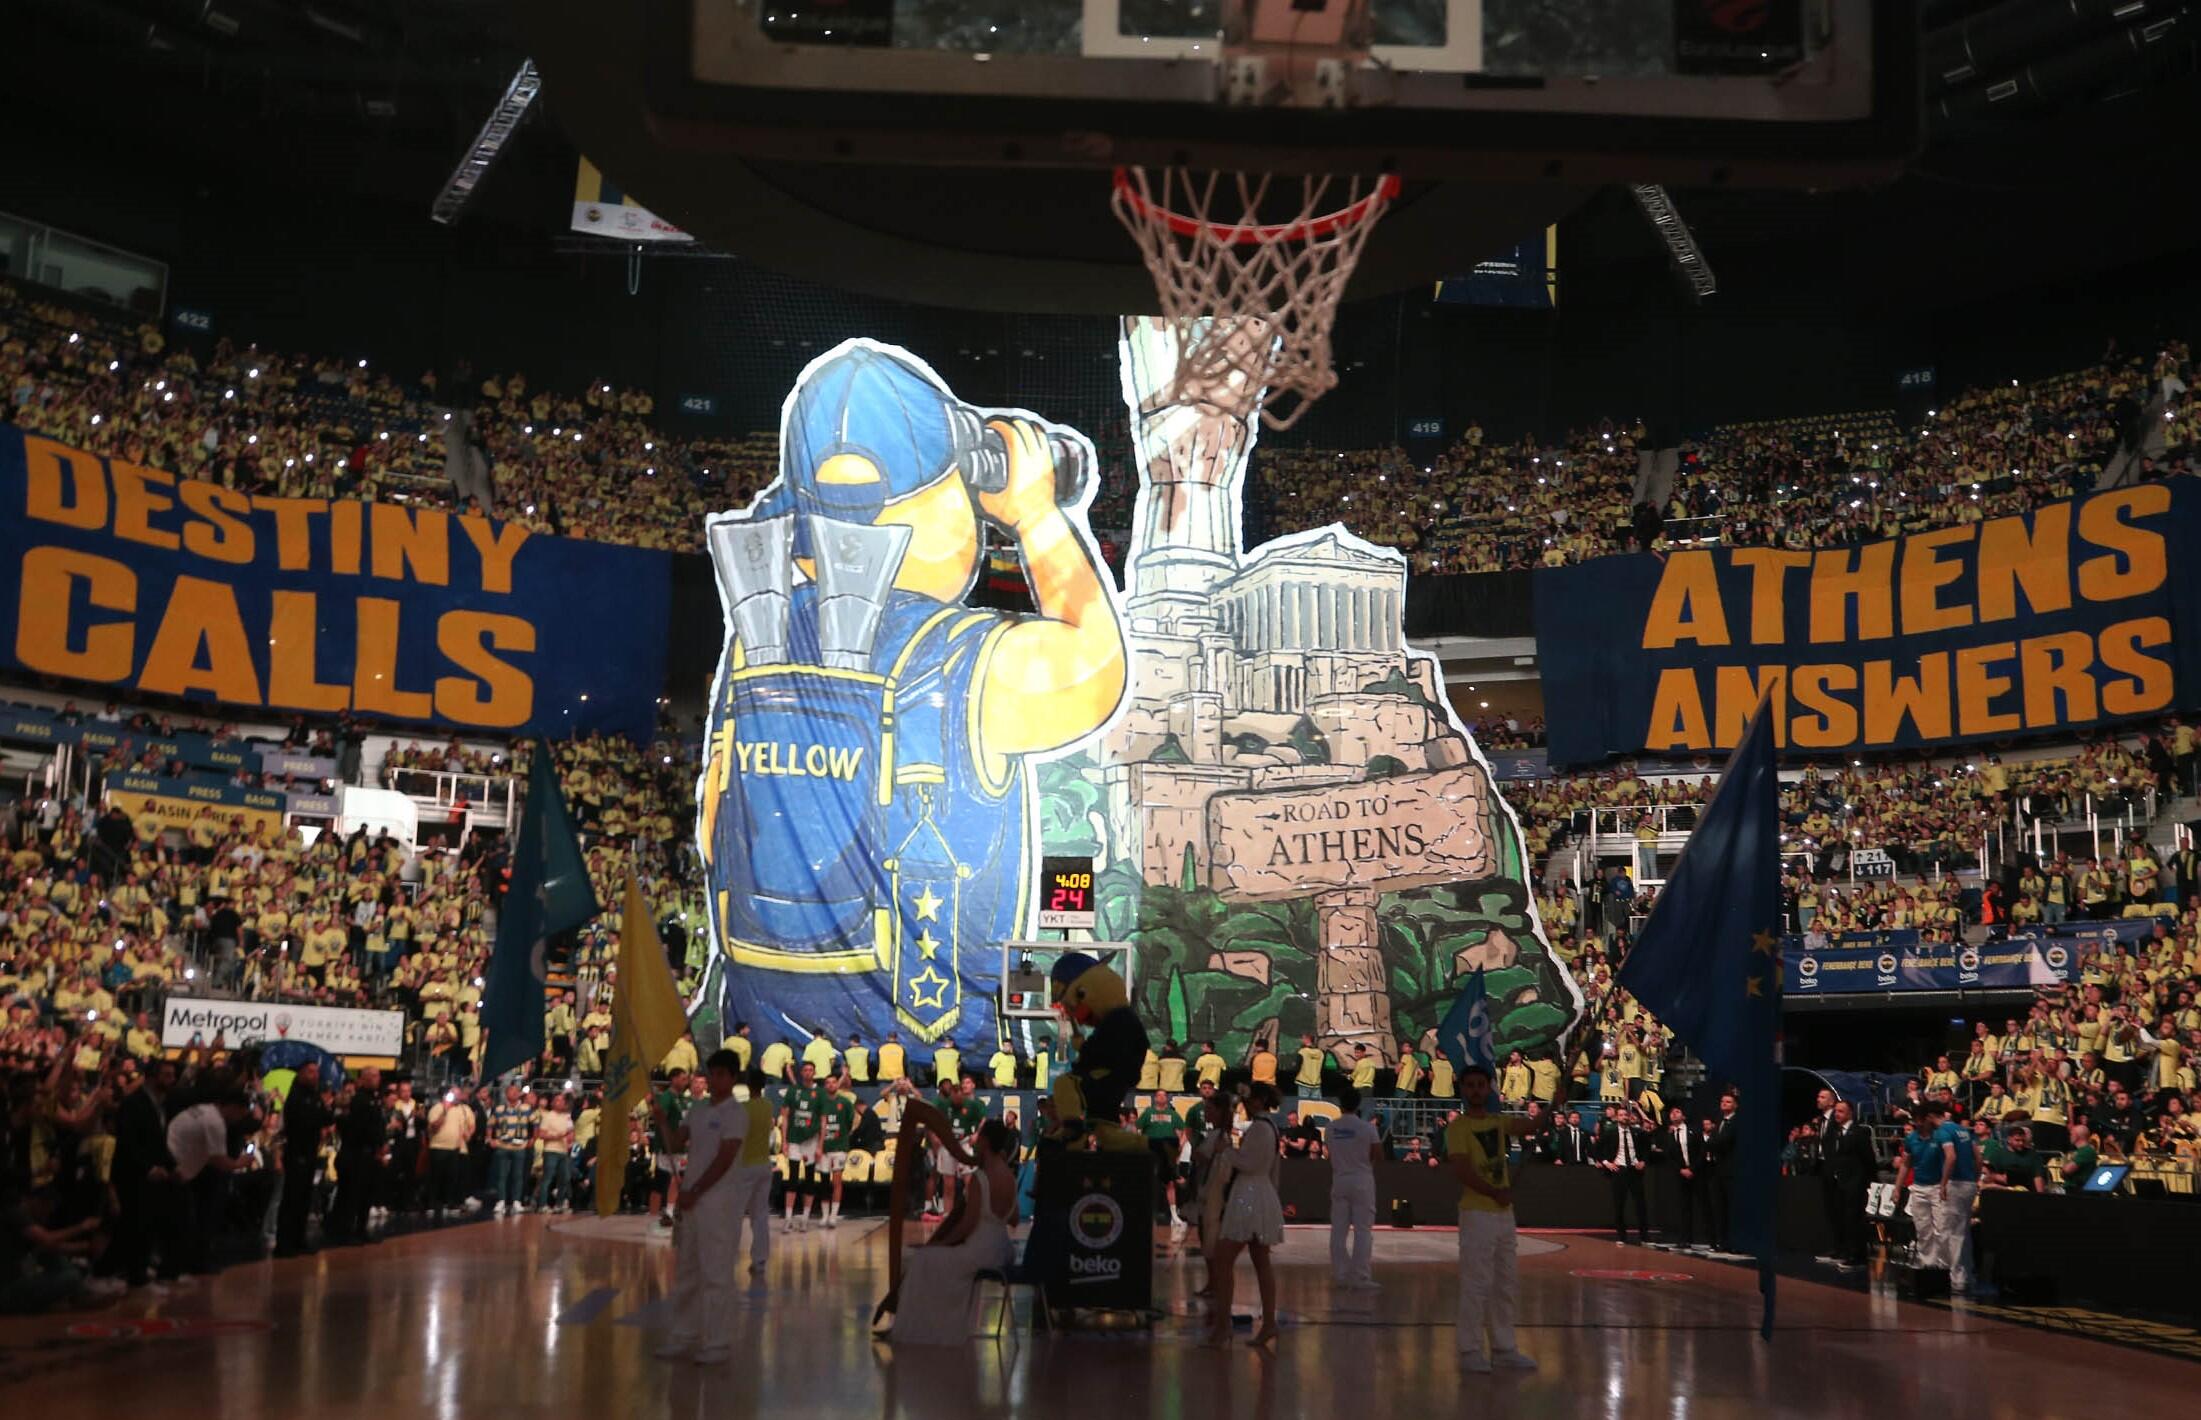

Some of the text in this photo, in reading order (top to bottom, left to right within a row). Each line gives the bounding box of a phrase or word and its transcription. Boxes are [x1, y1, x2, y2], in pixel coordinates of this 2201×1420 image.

[178, 312, 209, 329] 422
[1901, 371, 1932, 385] 418
[684, 398, 711, 411] 421
[1412, 422, 1441, 433] 419
[24, 434, 530, 593] DESTINY
[1642, 484, 2172, 649] ATHENS
[15, 545, 536, 728] CALLS
[1644, 615, 2174, 751] ANSWERS
[15, 722, 52, 737] PRESS
[82, 731, 117, 746] BASIN
[211, 751, 243, 765] BASIN
[282, 760, 316, 773] PRESS
[735, 738, 864, 782] YELLOW
[123, 777, 277, 809] BASIN PRESS BASIN
[156, 804, 192, 821] ASIN
[295, 799, 330, 812] PRESS
[1282, 796, 1389, 823] ROAD TO
[1267, 824, 1426, 867] ATHENS
[1867, 864, 1891, 875] 117
[1051, 889, 1083, 911] 24
[1043, 914, 1066, 924] YKT
[1800, 977, 1819, 986] beko
[1878, 974, 1897, 983] beko
[1959, 972, 1979, 980] beko
[169, 1008, 268, 1033] Metropol
[1070, 1253, 1121, 1272] beko
